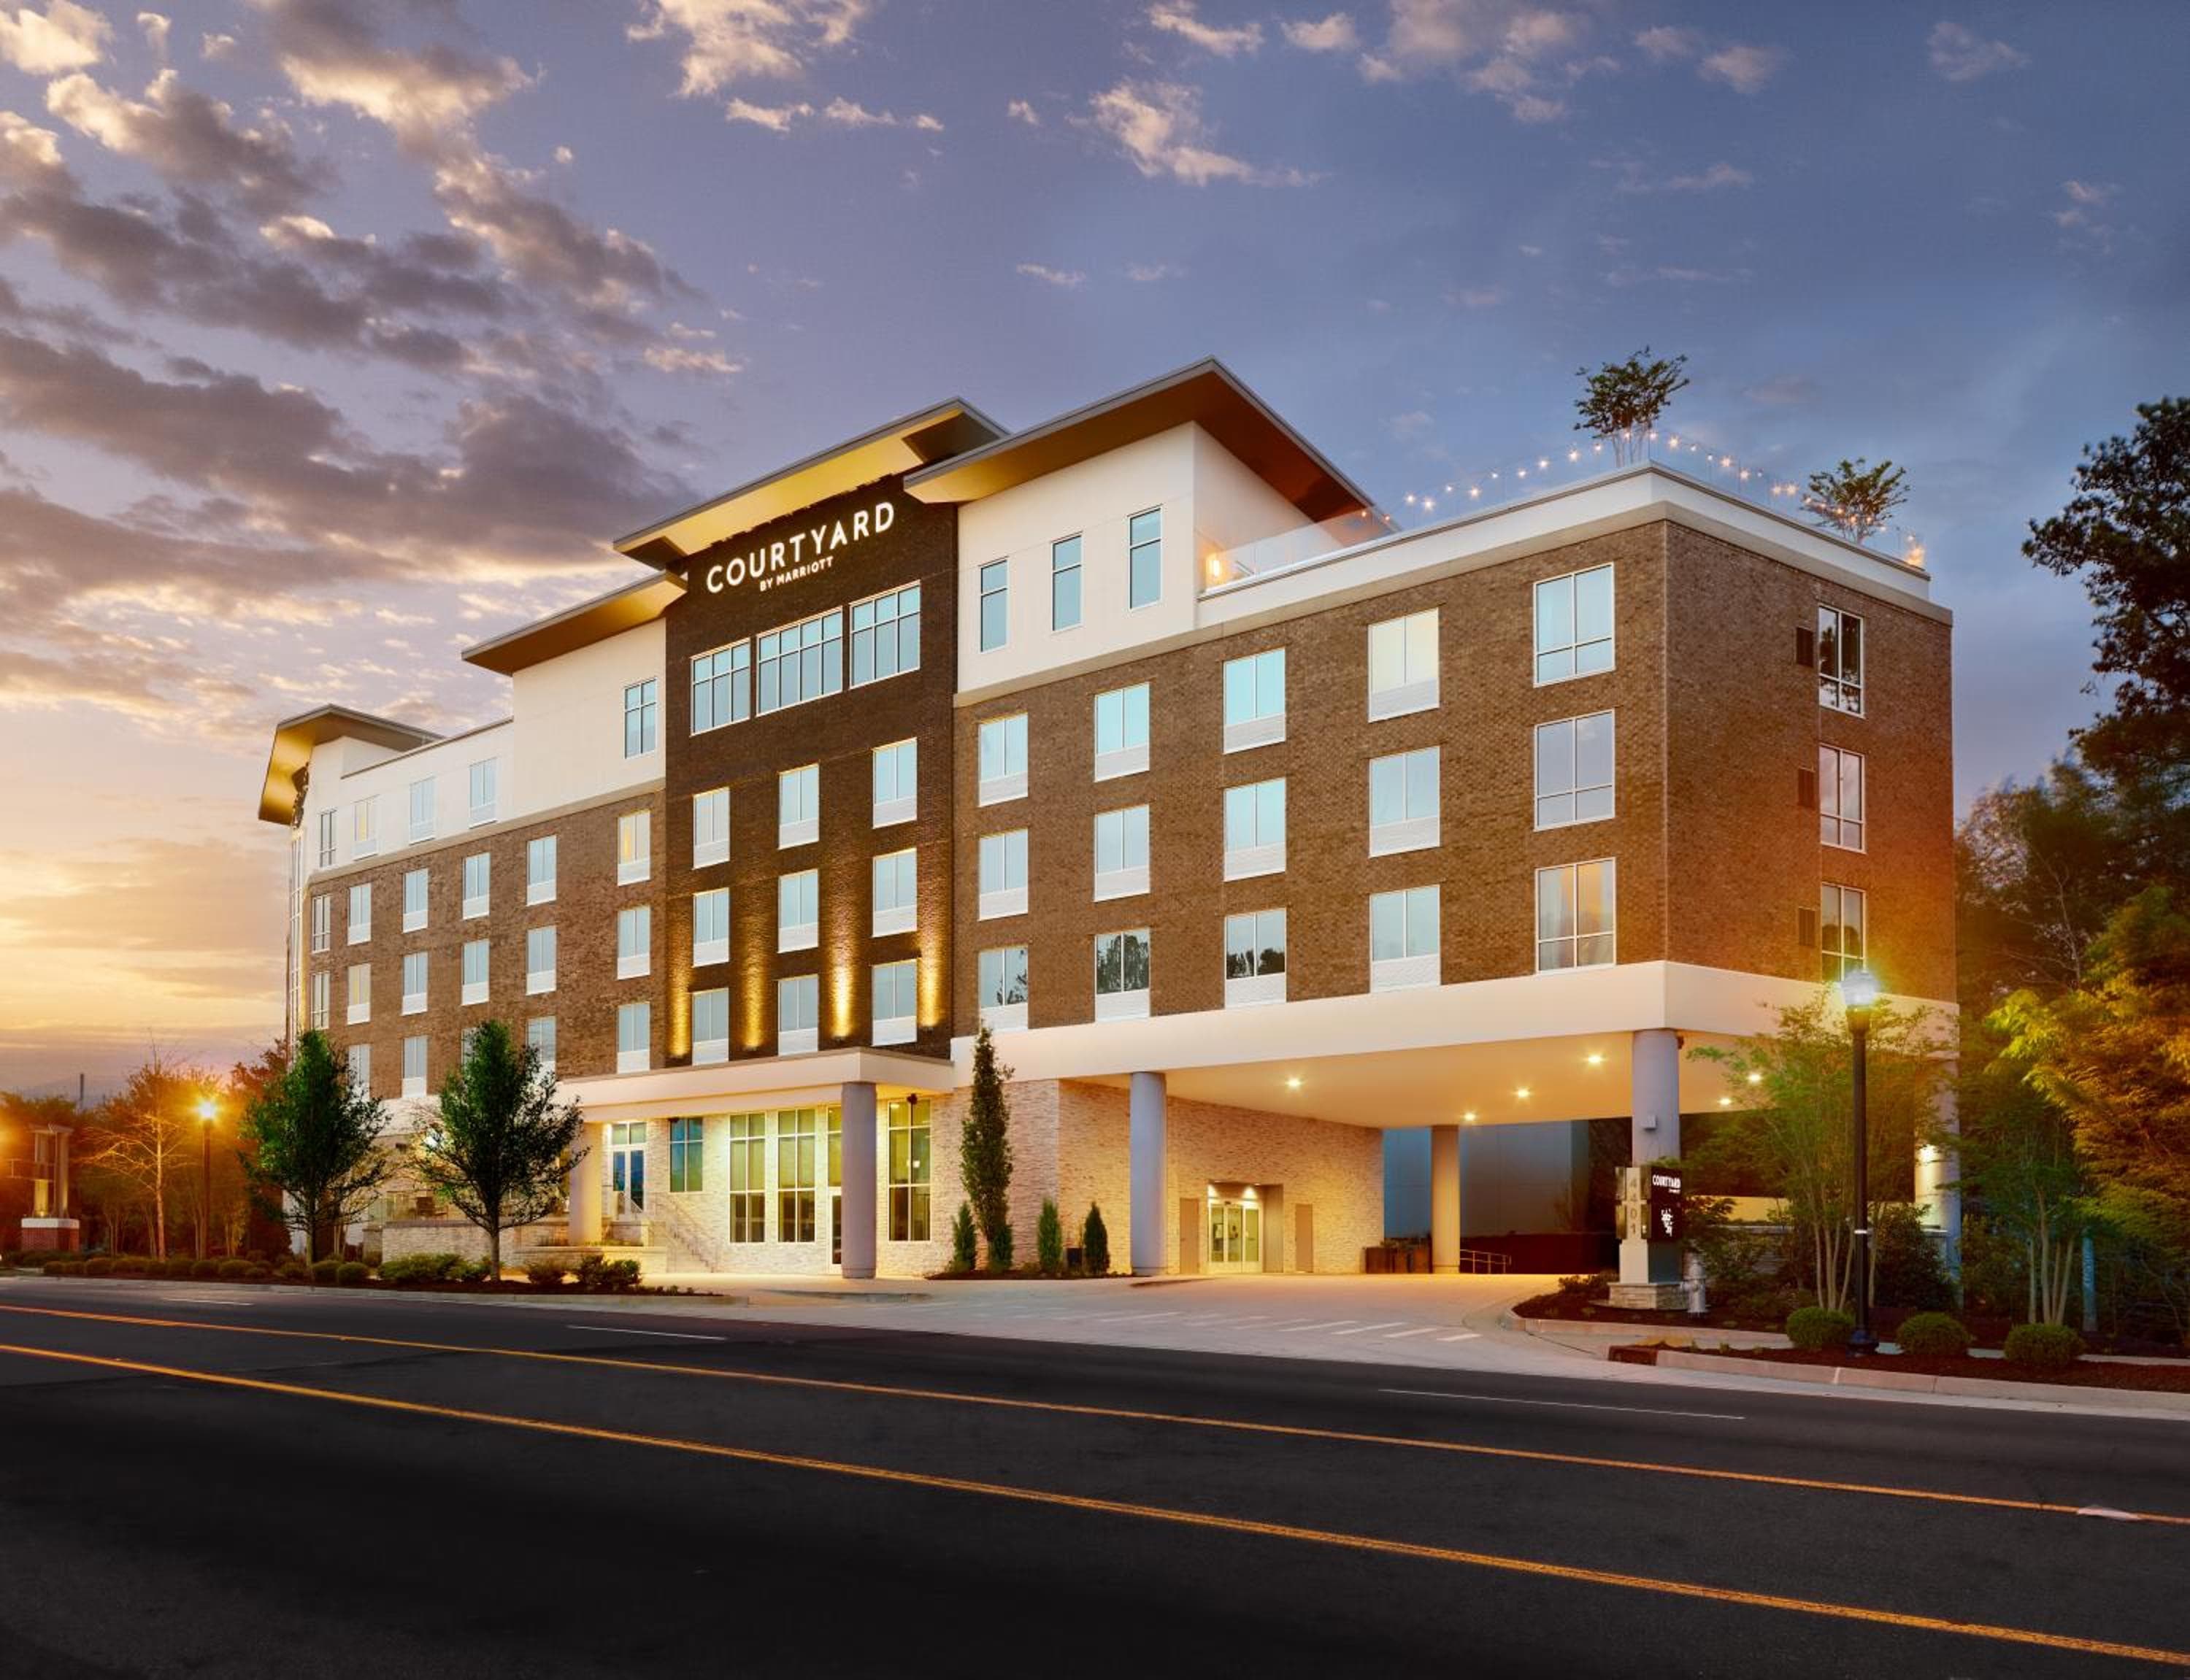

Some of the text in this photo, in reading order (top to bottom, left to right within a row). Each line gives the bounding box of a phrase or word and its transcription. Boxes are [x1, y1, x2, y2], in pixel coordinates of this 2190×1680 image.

[706, 501, 895, 593] COURTYARD
[759, 555, 834, 592] BY MARRIOTT
